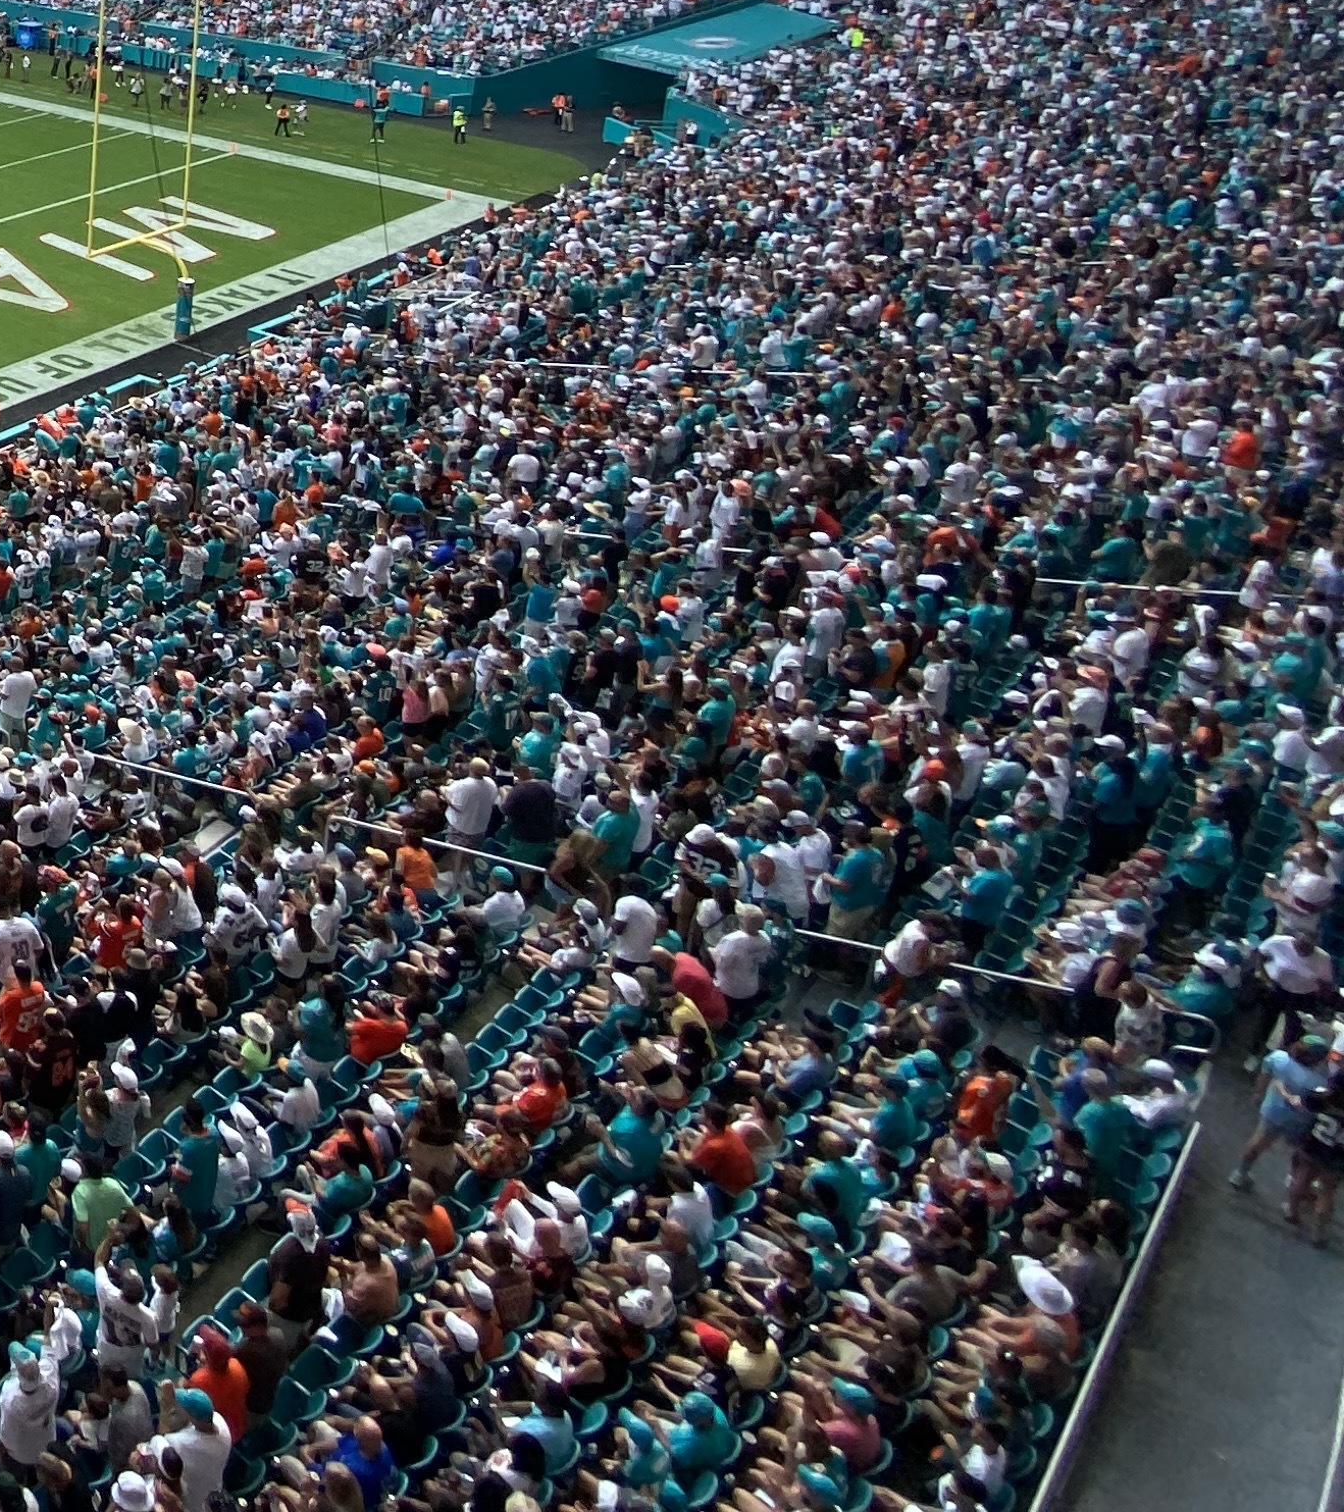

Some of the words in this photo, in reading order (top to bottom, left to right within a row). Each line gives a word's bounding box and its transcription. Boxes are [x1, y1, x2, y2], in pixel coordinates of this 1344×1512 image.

[267, 268, 316, 286] IT
[82, 324, 164, 354] ALL
[36, 354, 93, 380] OF
